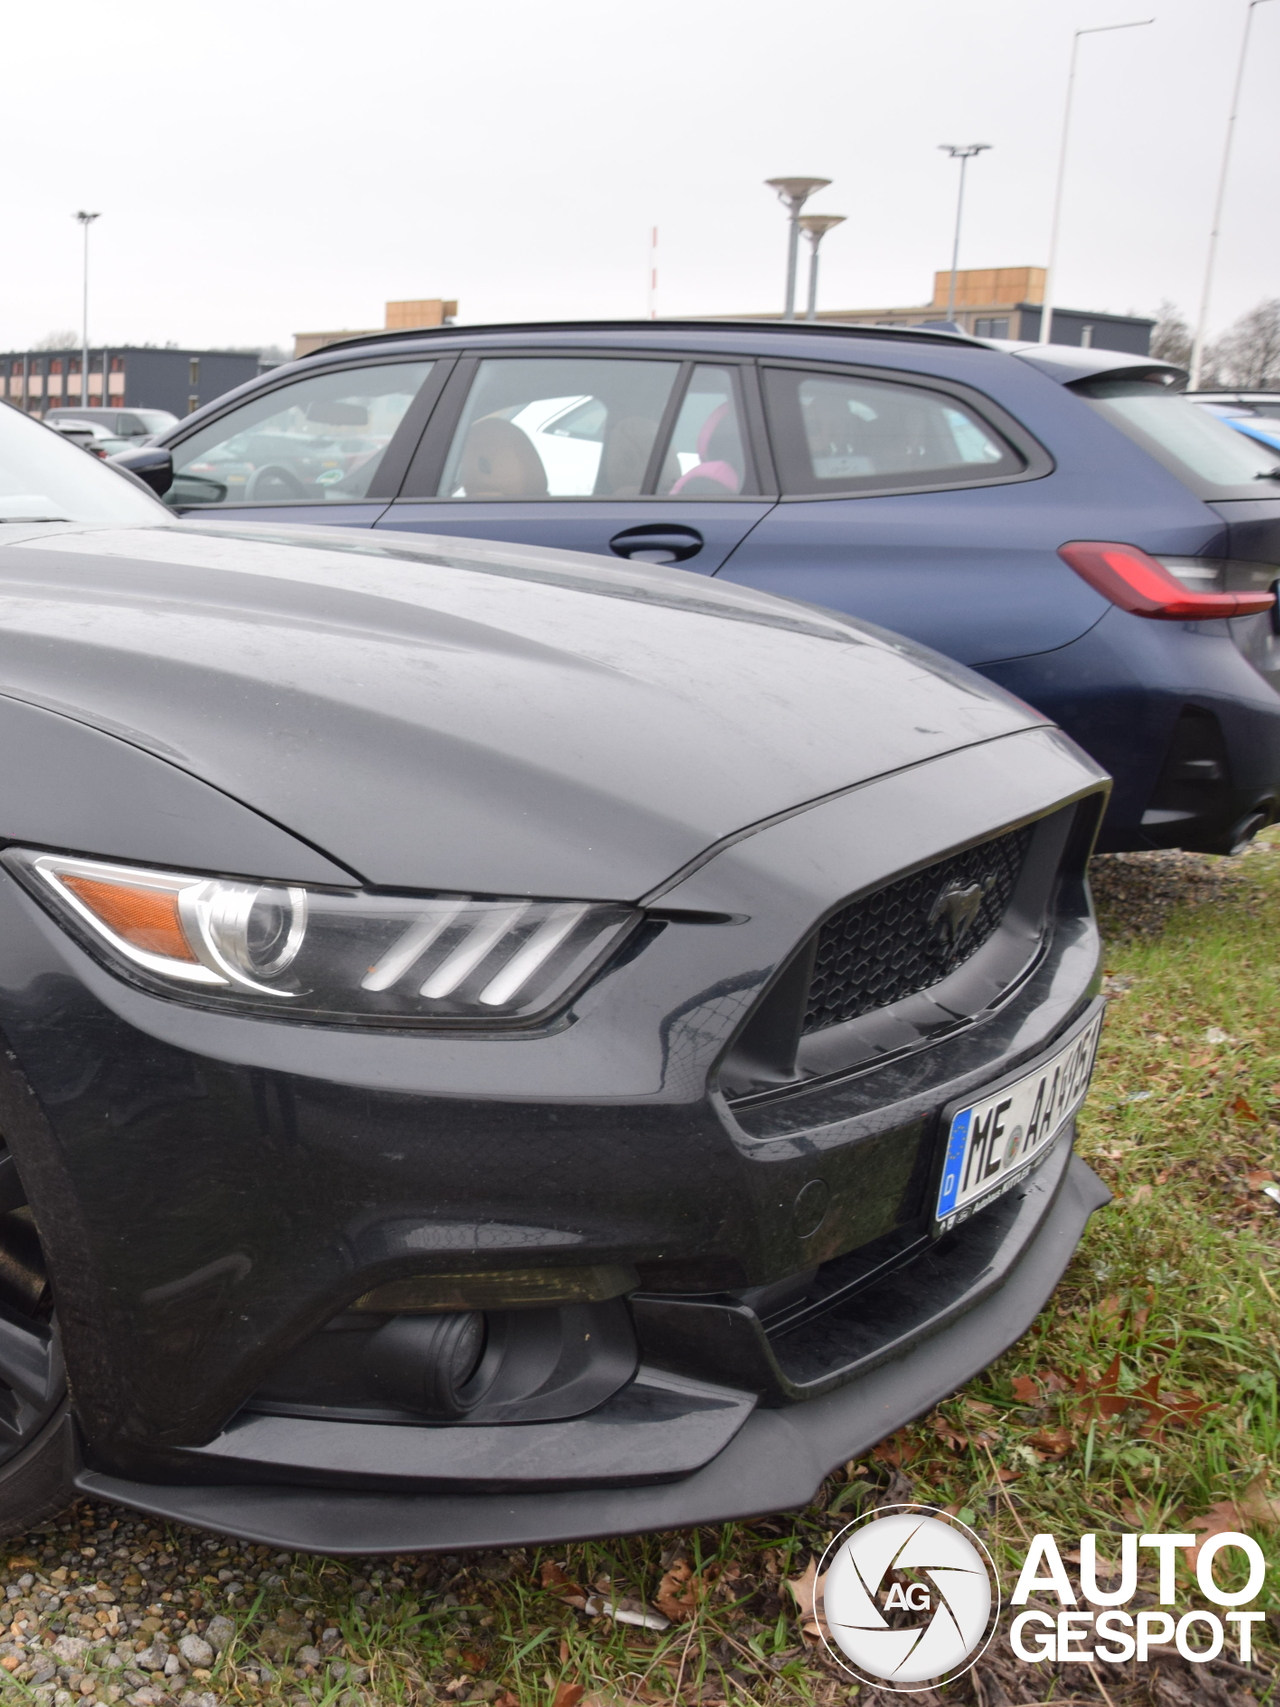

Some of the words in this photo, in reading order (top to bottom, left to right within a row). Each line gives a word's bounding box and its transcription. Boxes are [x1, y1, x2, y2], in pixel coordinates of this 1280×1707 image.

[961, 1096, 1013, 1193] ME
[1023, 1064, 1061, 1154] AA
[943, 1173, 955, 1197] D
